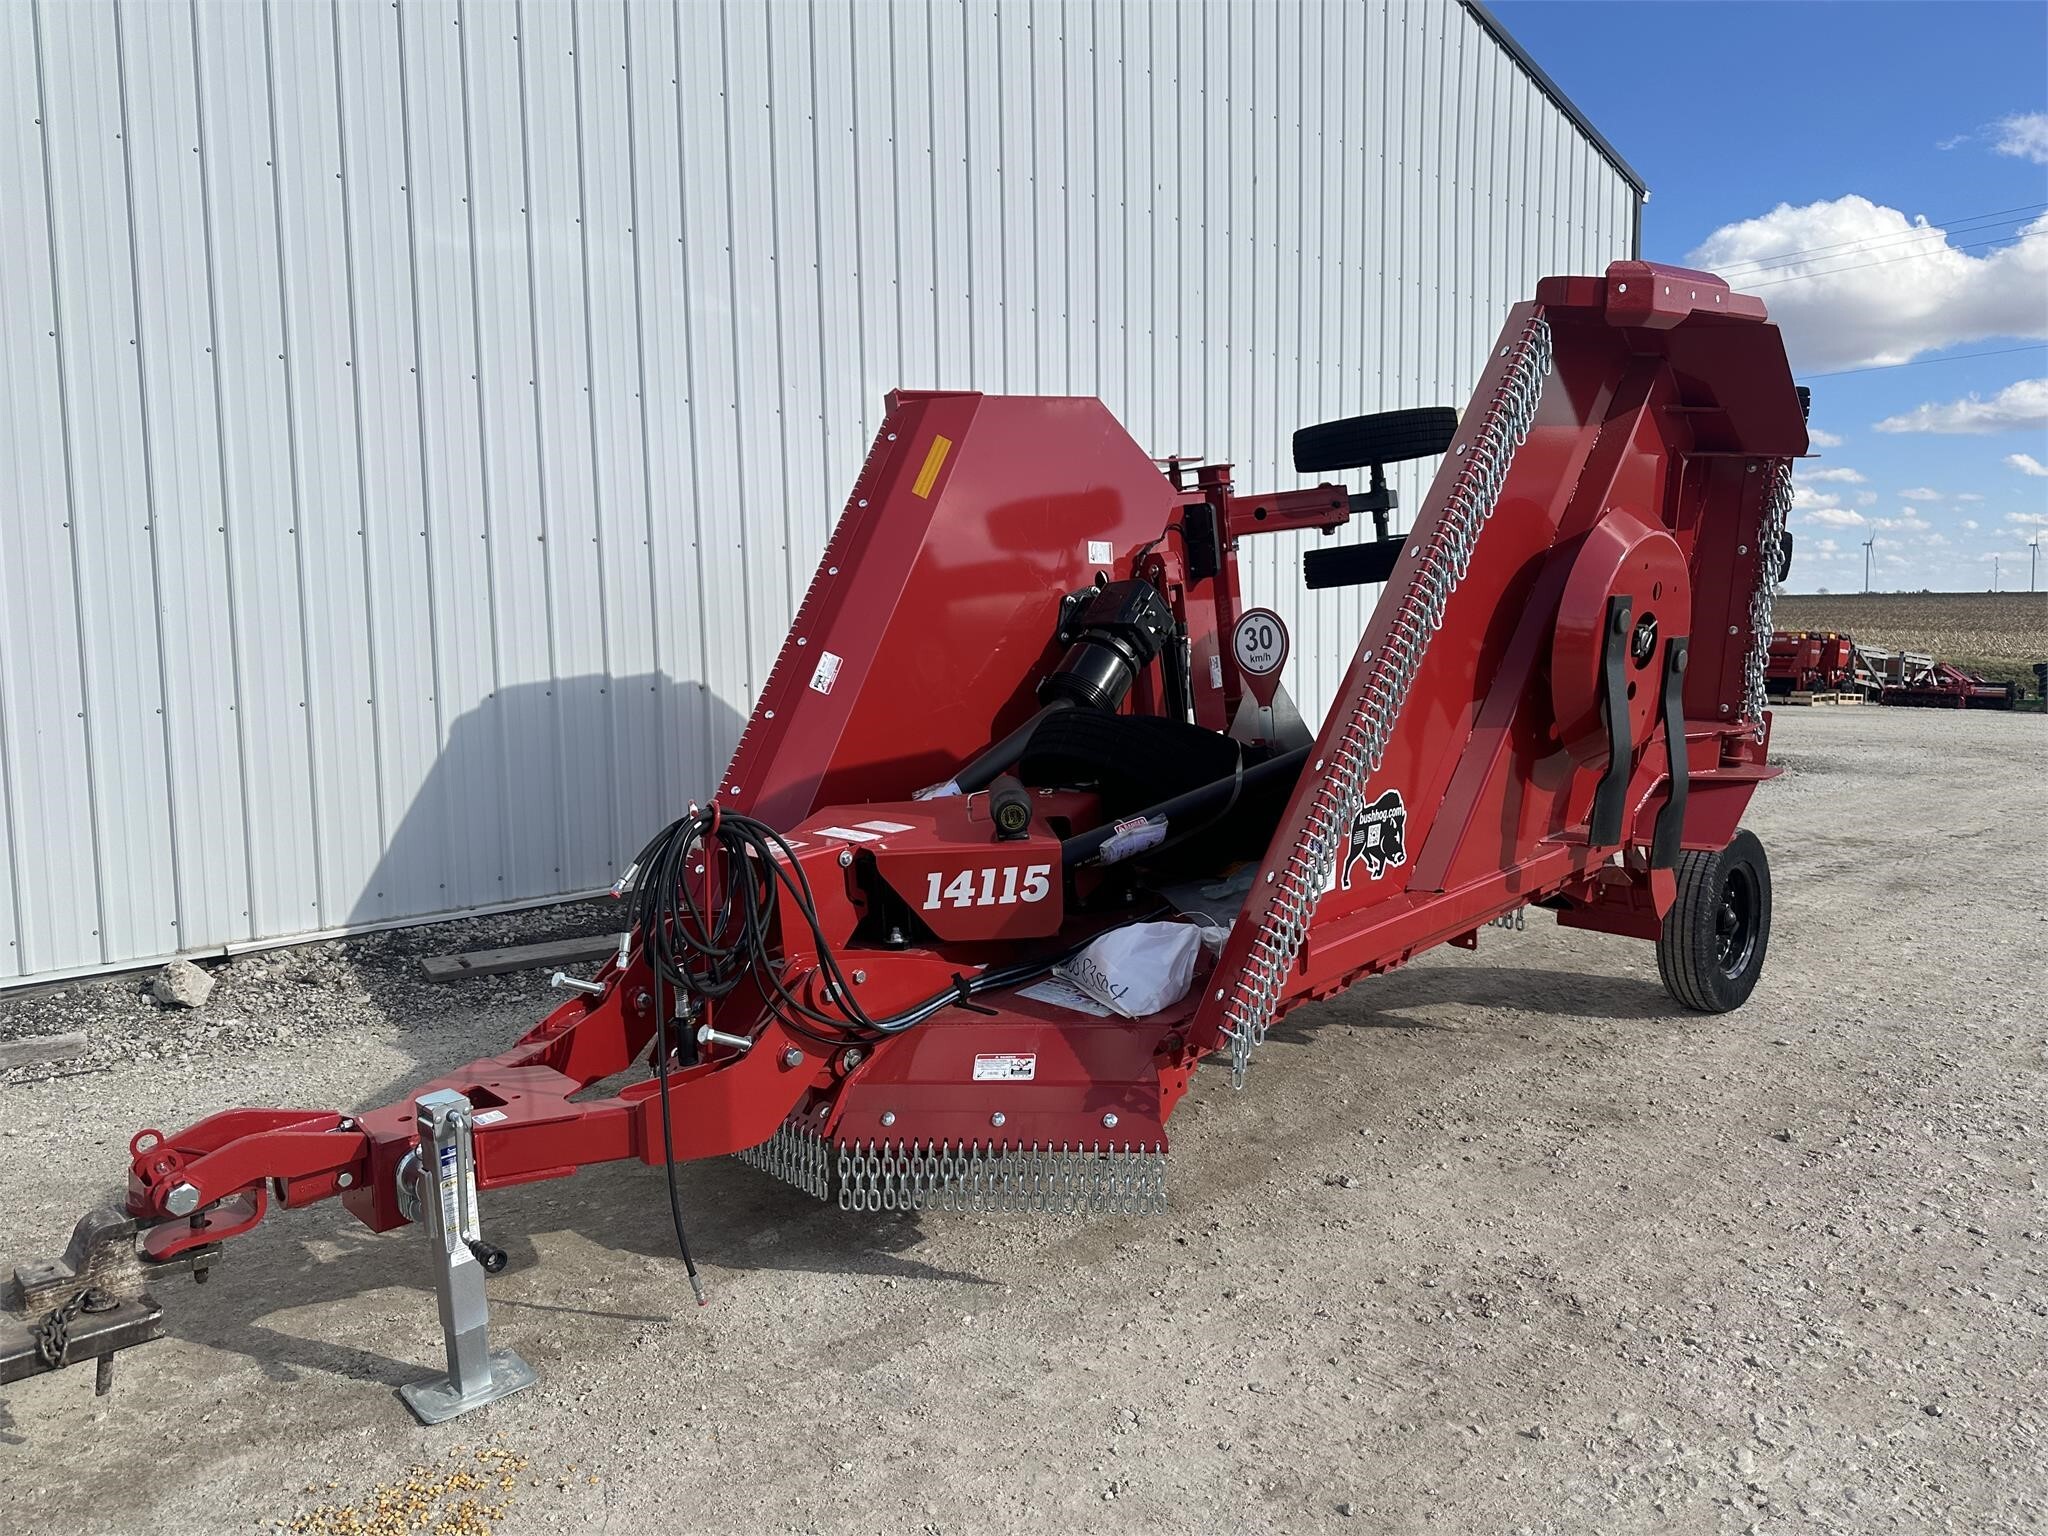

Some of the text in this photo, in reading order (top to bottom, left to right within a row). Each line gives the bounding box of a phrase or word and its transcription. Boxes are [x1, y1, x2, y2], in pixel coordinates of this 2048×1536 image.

[1244, 625, 1273, 652] 30
[1249, 652, 1272, 664] km/h
[1359, 806, 1402, 825] bushhog.com
[922, 864, 1051, 910] 14115
